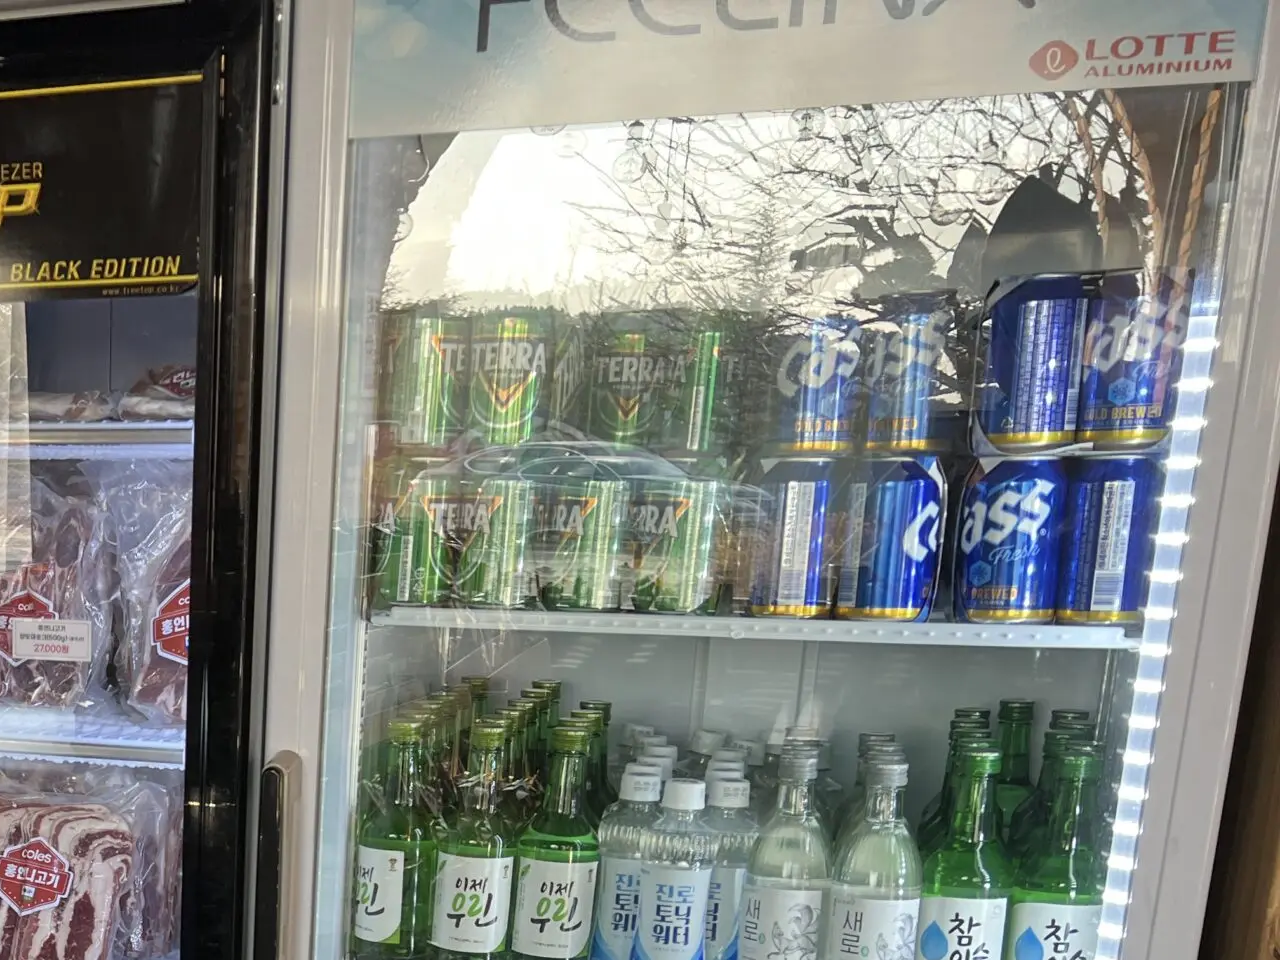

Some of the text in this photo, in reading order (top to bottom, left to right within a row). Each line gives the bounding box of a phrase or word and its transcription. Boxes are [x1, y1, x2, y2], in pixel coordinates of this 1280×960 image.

[1085, 30, 1236, 60] LOTTE
[1084, 58, 1232, 78] ALUMINIUM
[10, 256, 182, 282] BLACK EDITION
[473, 342, 547, 375] TERRA
[21, 848, 52, 864] coles
[455, 876, 489, 895] 이제
[540, 880, 575, 898] 이제
[655, 882, 696, 904] 진로
[446, 892, 498, 929] 우린
[531, 896, 583, 934] 우린
[655, 903, 692, 926] 토닉
[652, 923, 690, 947] 워터
